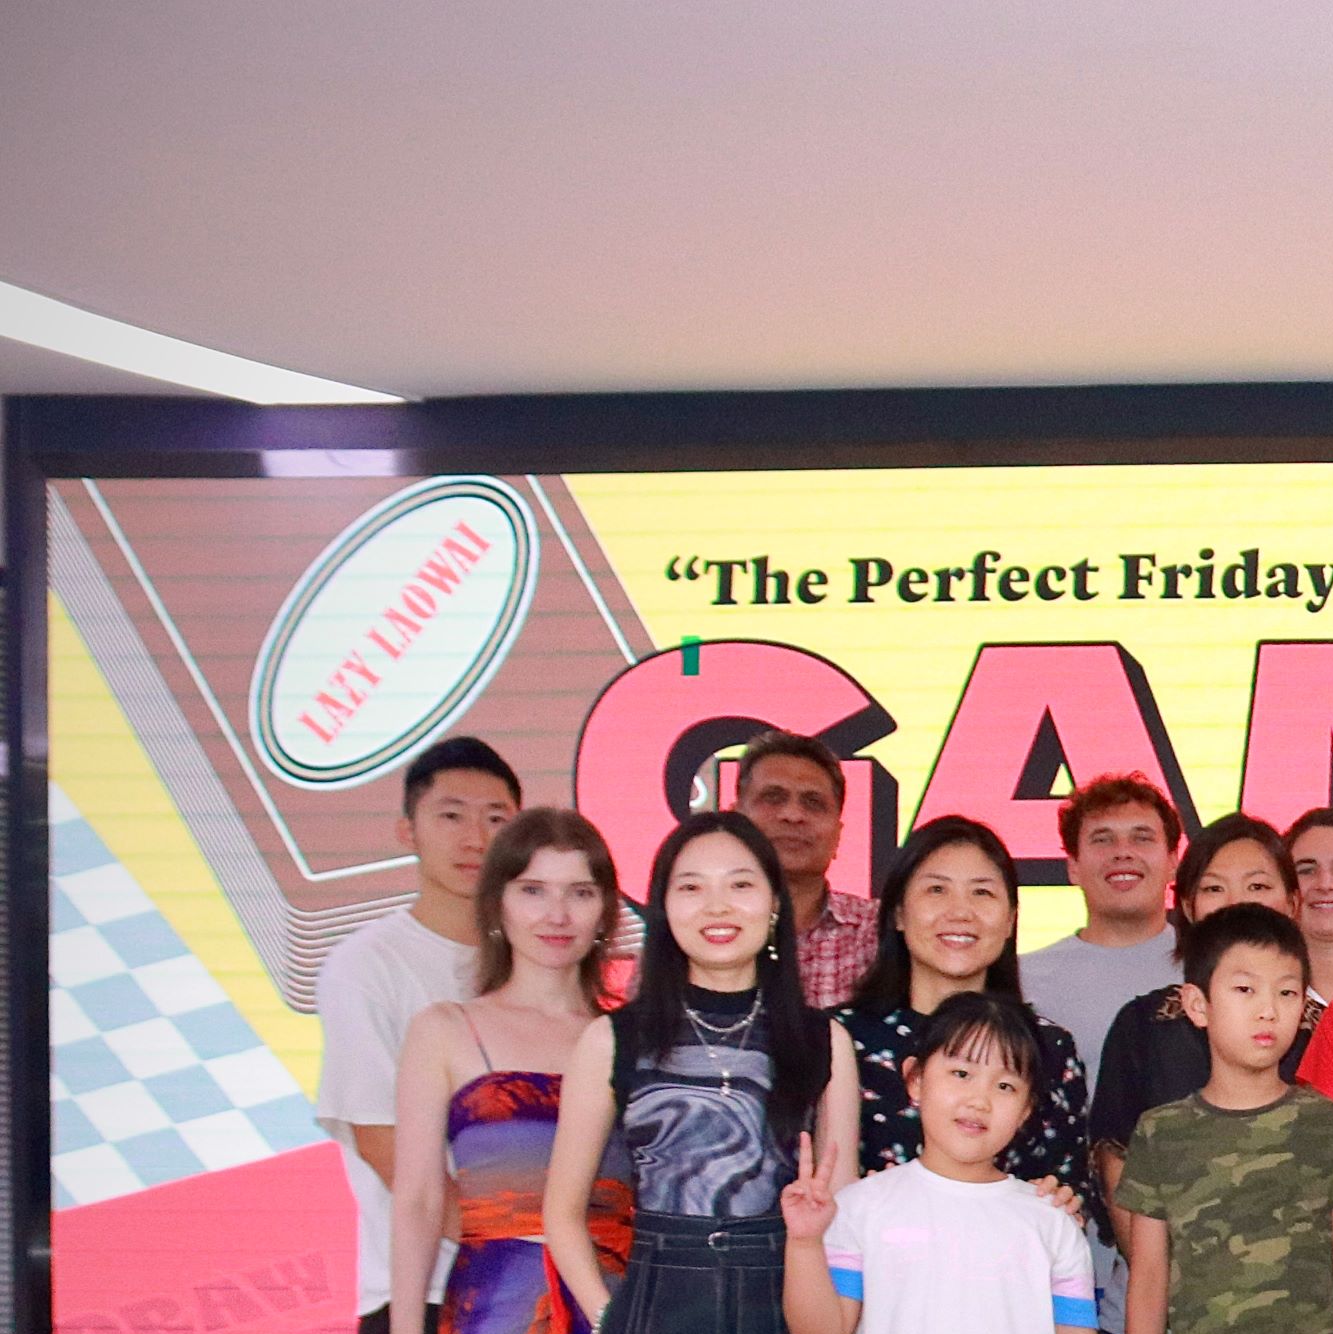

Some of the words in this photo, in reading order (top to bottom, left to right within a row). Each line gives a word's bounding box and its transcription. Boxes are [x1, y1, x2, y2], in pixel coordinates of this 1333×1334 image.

[299, 649, 382, 744] LAZY
[367, 519, 491, 661] LAOWAI
[665, 555, 828, 605] “The
[847, 550, 1100, 604] Perfect
